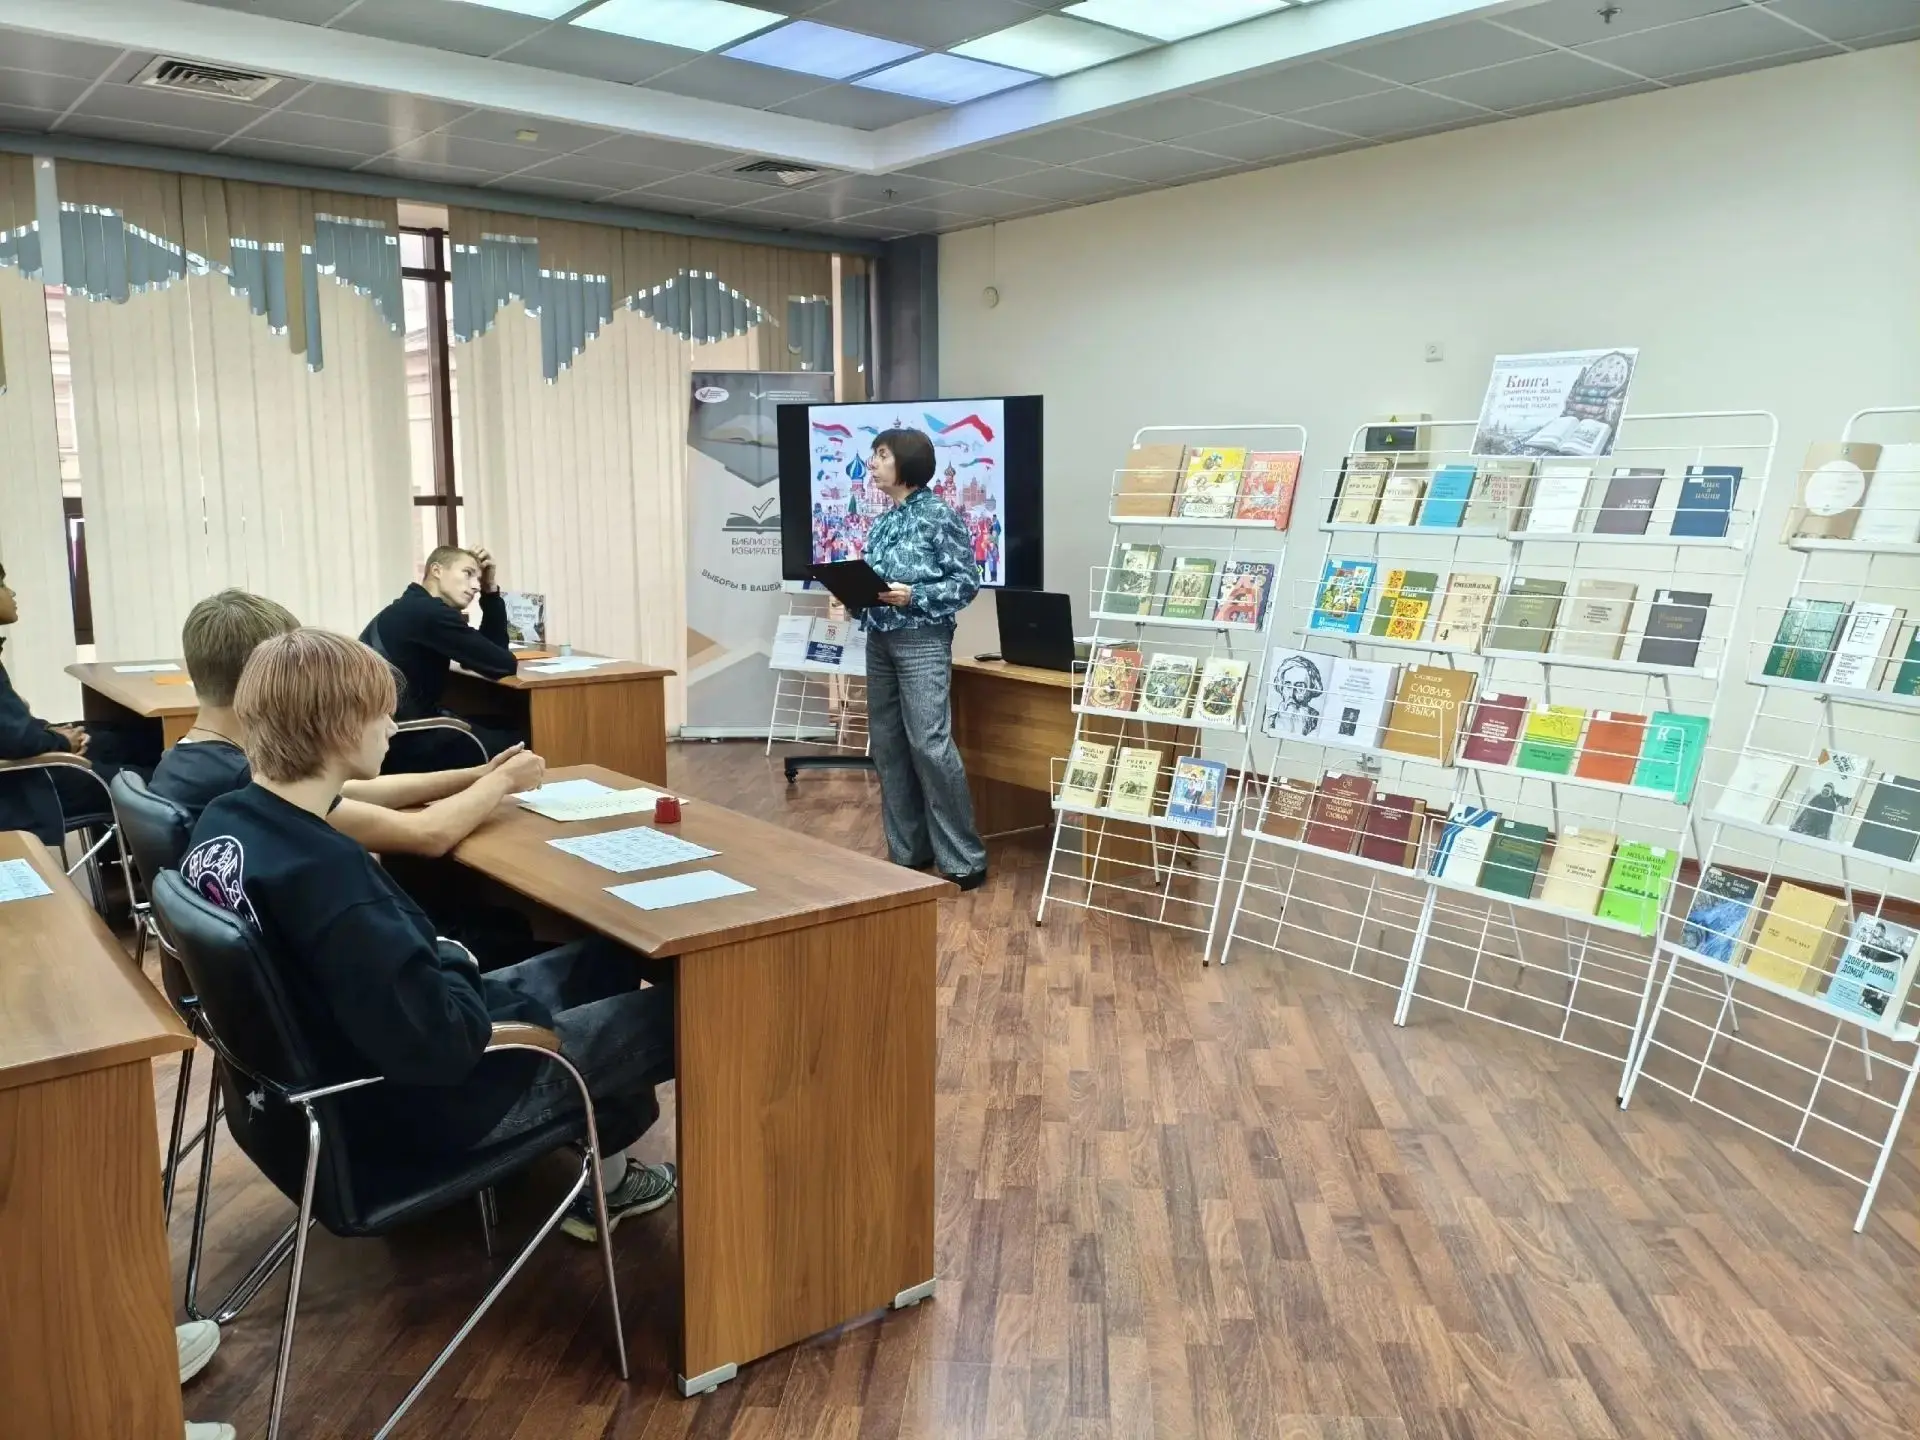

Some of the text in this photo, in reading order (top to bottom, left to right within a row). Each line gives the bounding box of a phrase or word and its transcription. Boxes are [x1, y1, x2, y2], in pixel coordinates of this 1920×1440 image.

[1506, 375, 1549, 388] Книга
[1226, 563, 1270, 575] КВАРЬ
[701, 568, 739, 590] ВЫБОРЫ
[750, 581, 782, 592] ВАШЕЙ
[1440, 629, 1449, 641] 4
[1411, 683, 1451, 698] СЛОВАРЬ
[1408, 693, 1454, 710] РУССКОГО
[1404, 704, 1436, 718] ЯЗЫКА
[1841, 964, 1865, 979] ДОМОЙ
[1845, 954, 1895, 981] ДОЛГАЯ ДОРОГА
